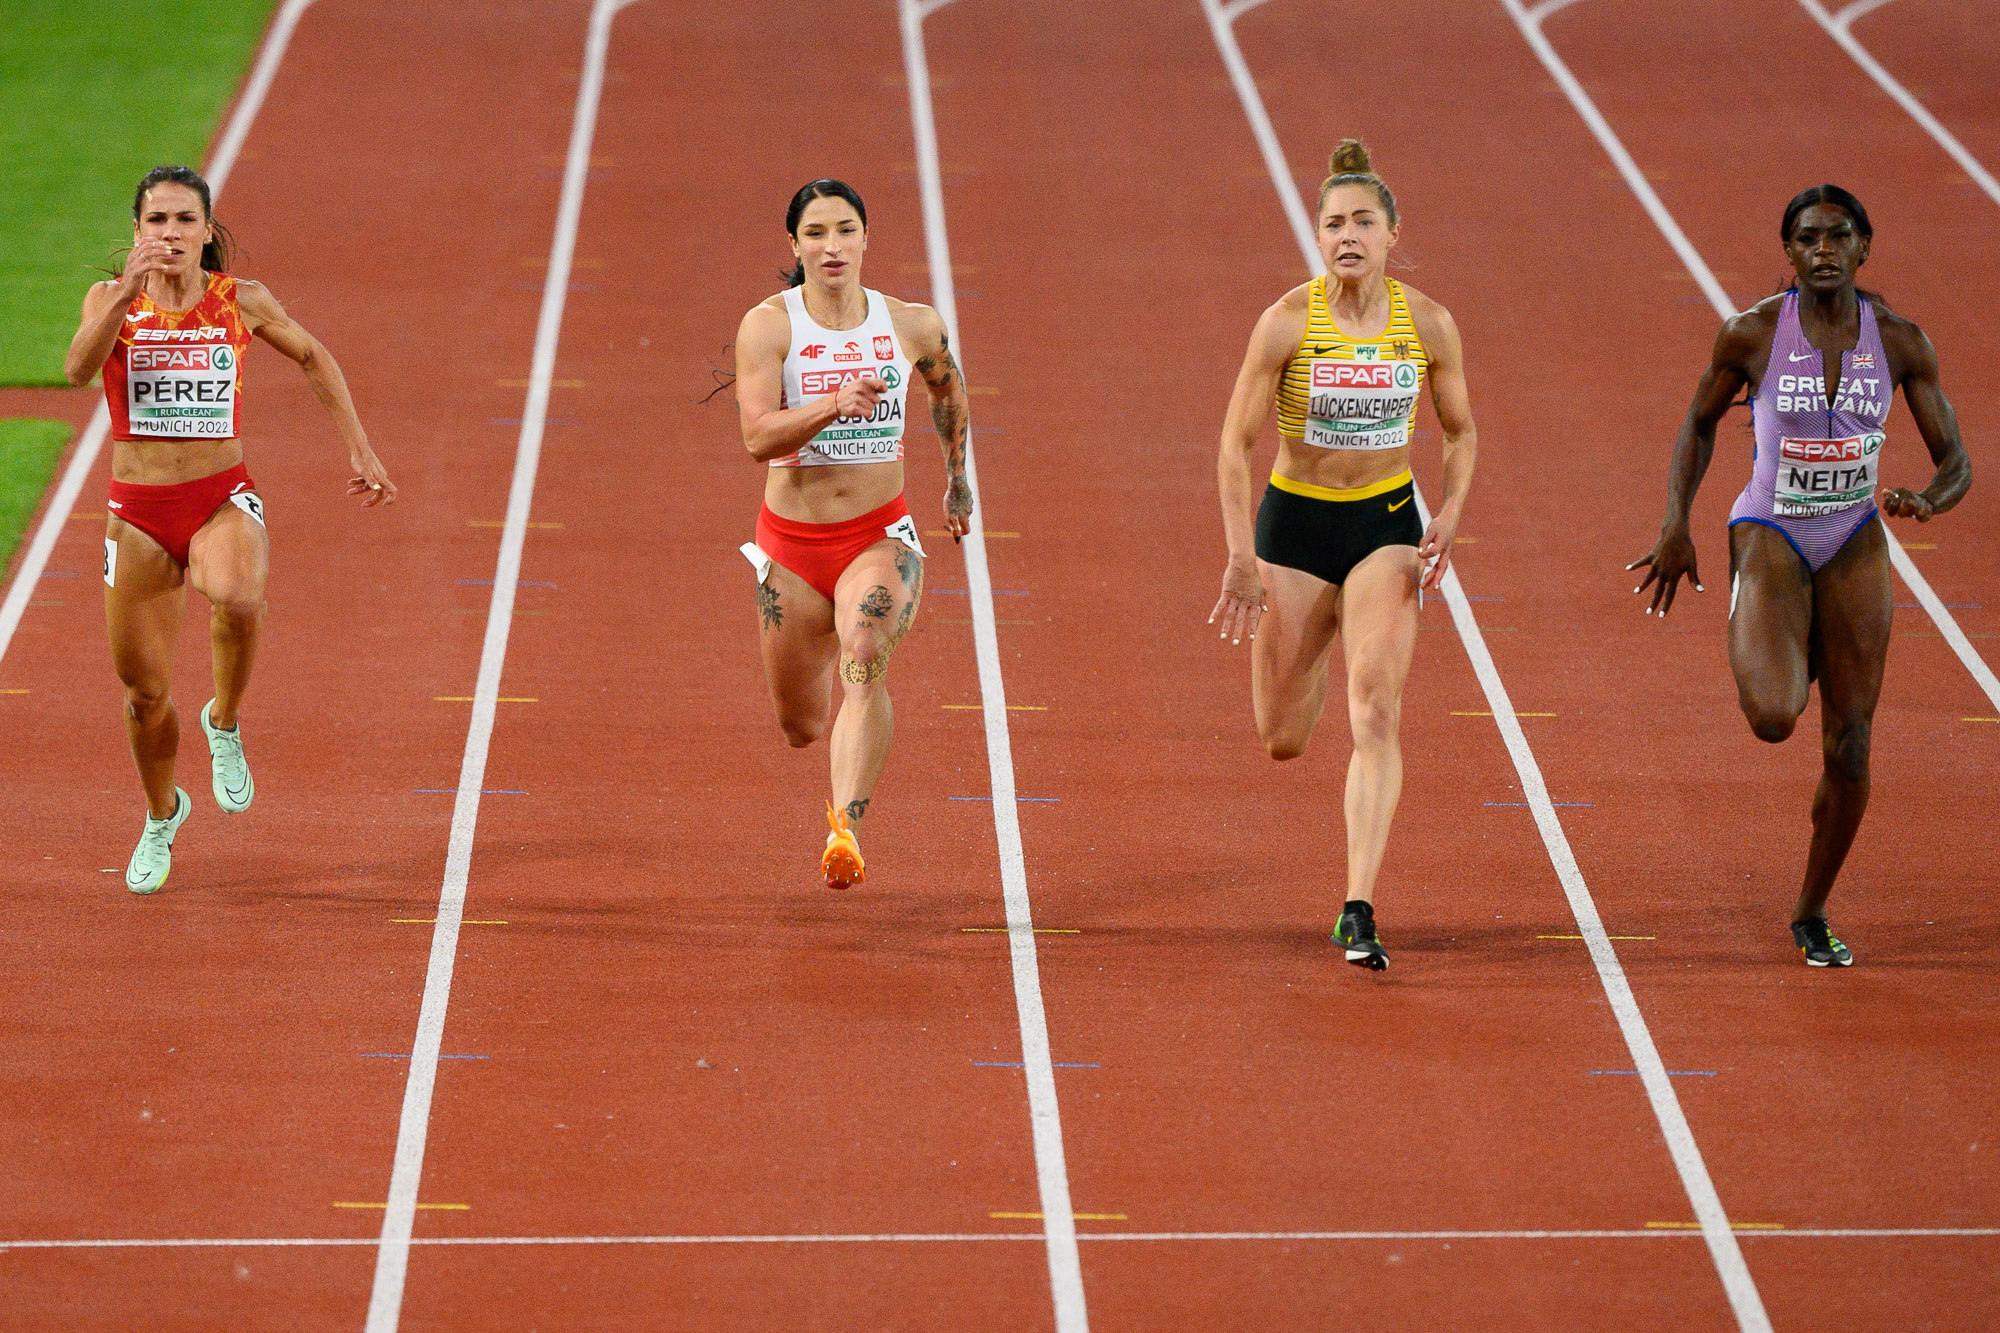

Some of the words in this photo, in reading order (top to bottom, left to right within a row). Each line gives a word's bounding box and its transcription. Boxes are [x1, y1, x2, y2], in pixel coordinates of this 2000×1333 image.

[133, 326, 226, 341] ESPAÑA
[133, 350, 208, 368] SPAR
[800, 344, 826, 358] 4F
[834, 353, 861, 361] ORLEN
[1315, 366, 1391, 385] SPAR
[134, 375, 231, 403] PÉREZ
[1778, 375, 1879, 397] GREAT
[160, 408, 180, 417] RUN
[1311, 392, 1413, 420] LÜCKENKEMPER
[1776, 395, 1882, 418] BRITAIN
[137, 420, 192, 433] MUNICH
[197, 420, 229, 434] 2022
[832, 430, 853, 439] RUN
[1337, 423, 1358, 432] RUN
[1312, 429, 1370, 446] MUNICH
[1374, 430, 1404, 446] 2022
[1784, 439, 1861, 459] SPAR
[1788, 464, 1869, 491] NEITA
[1782, 502, 1840, 516] MUNICH
